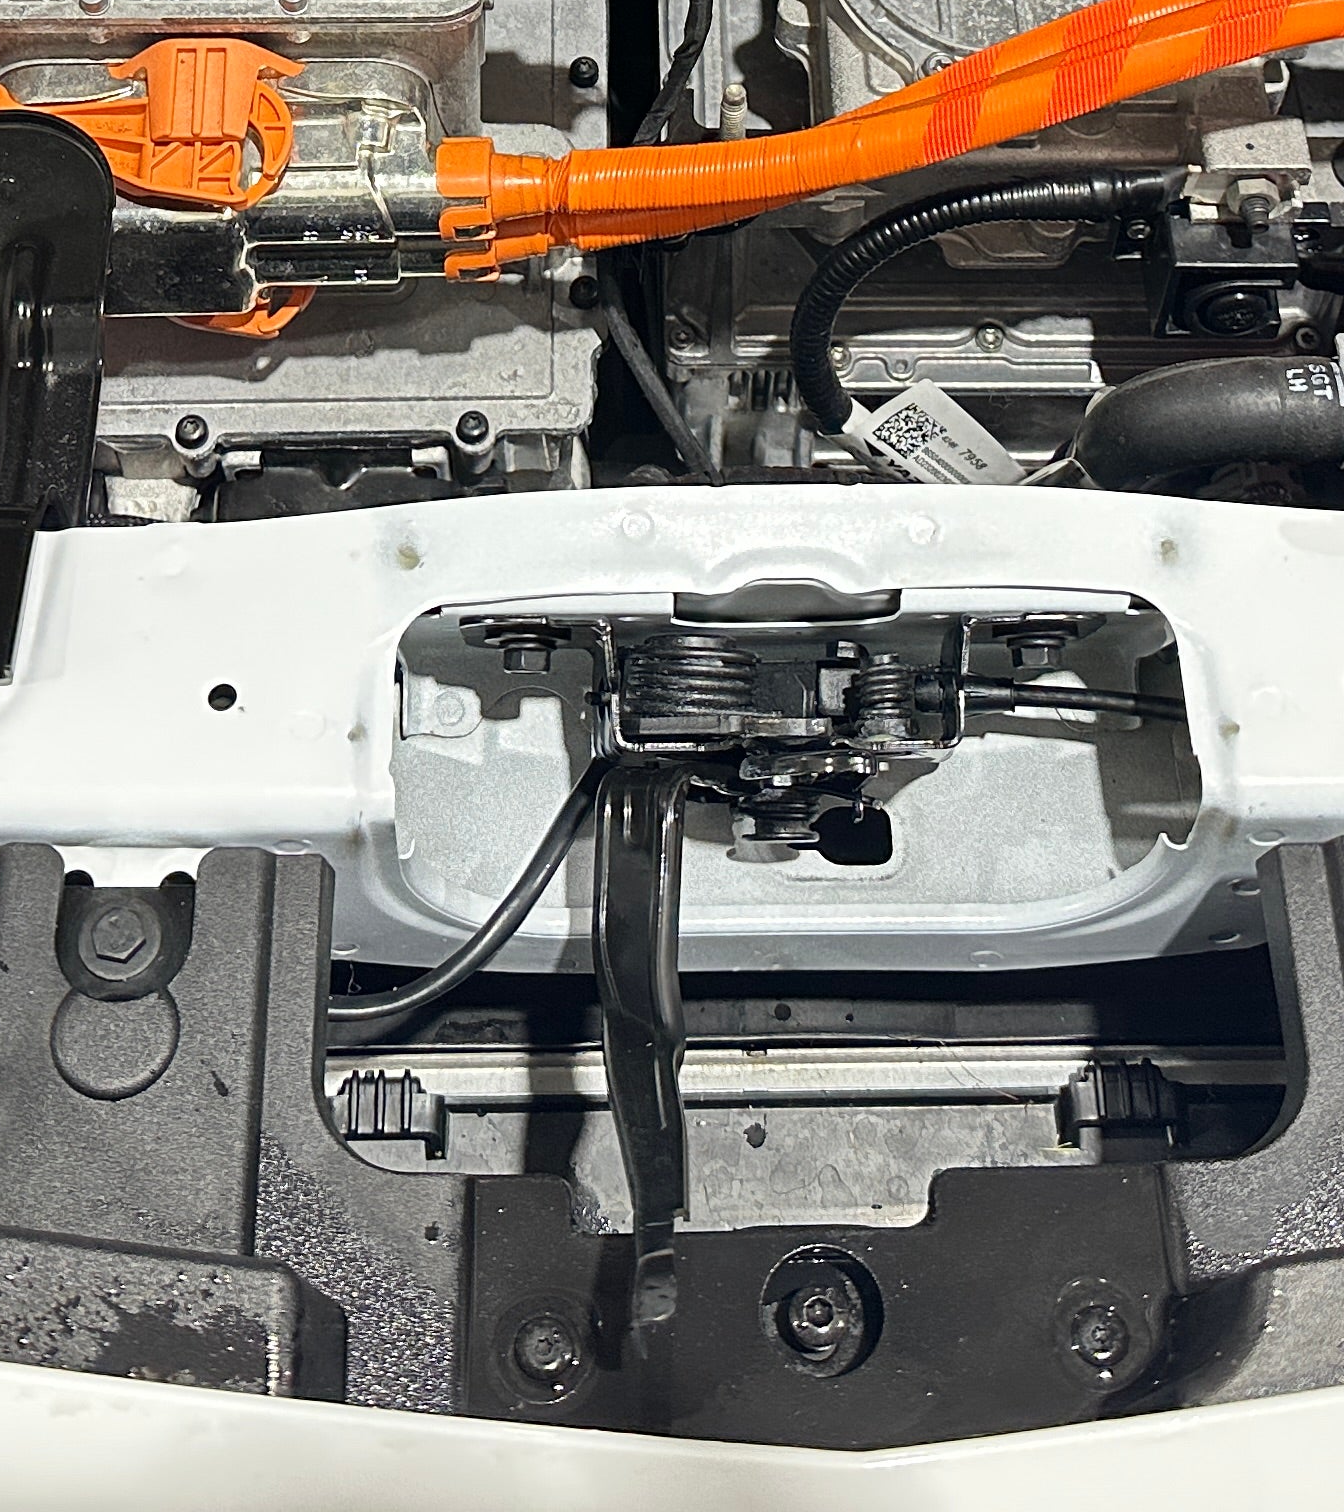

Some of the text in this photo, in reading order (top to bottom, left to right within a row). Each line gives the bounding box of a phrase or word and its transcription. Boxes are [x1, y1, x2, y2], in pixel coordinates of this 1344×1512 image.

[1285, 368, 1308, 391] LH
[1307, 363, 1333, 400] SGT
[957, 445, 990, 475] 7958
